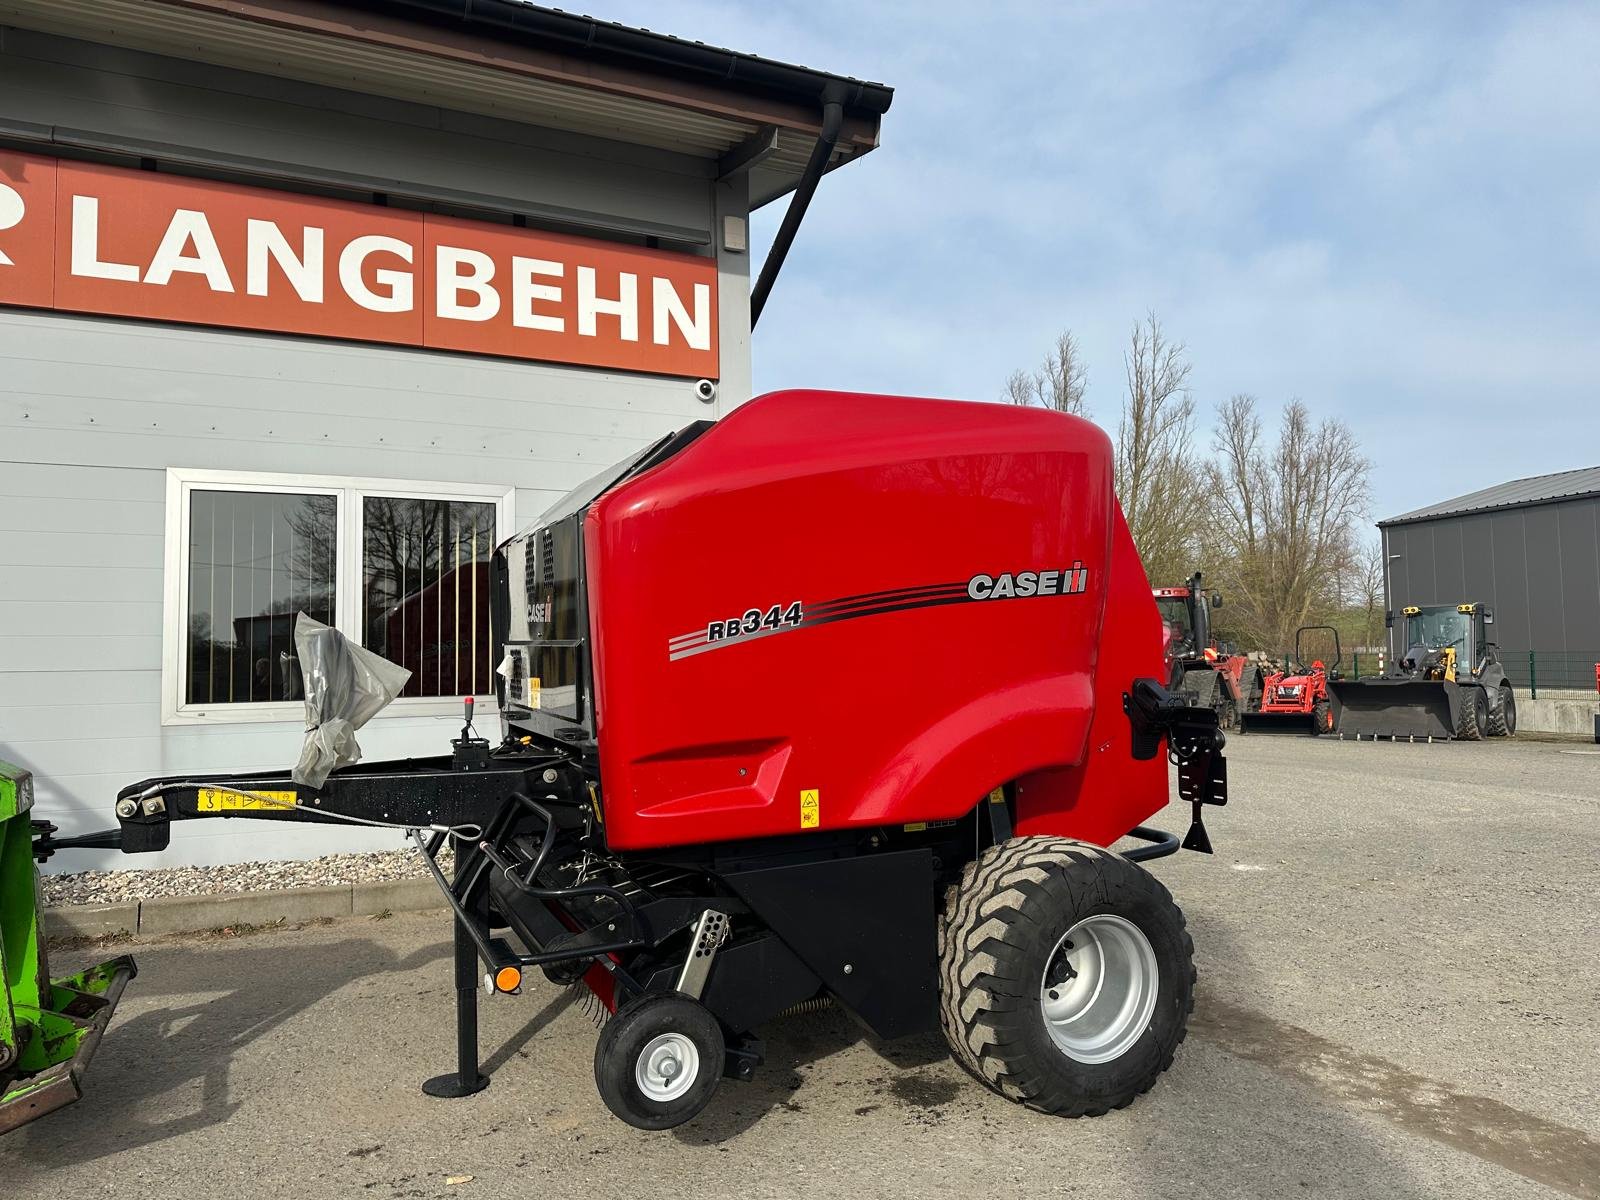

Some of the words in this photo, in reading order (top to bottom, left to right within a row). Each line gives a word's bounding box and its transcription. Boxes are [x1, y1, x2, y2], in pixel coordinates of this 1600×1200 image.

[71, 194, 710, 351] LANGBEHN
[967, 571, 1060, 600] CASE
[527, 603, 545, 623] CASE
[707, 601, 804, 643] RB344
